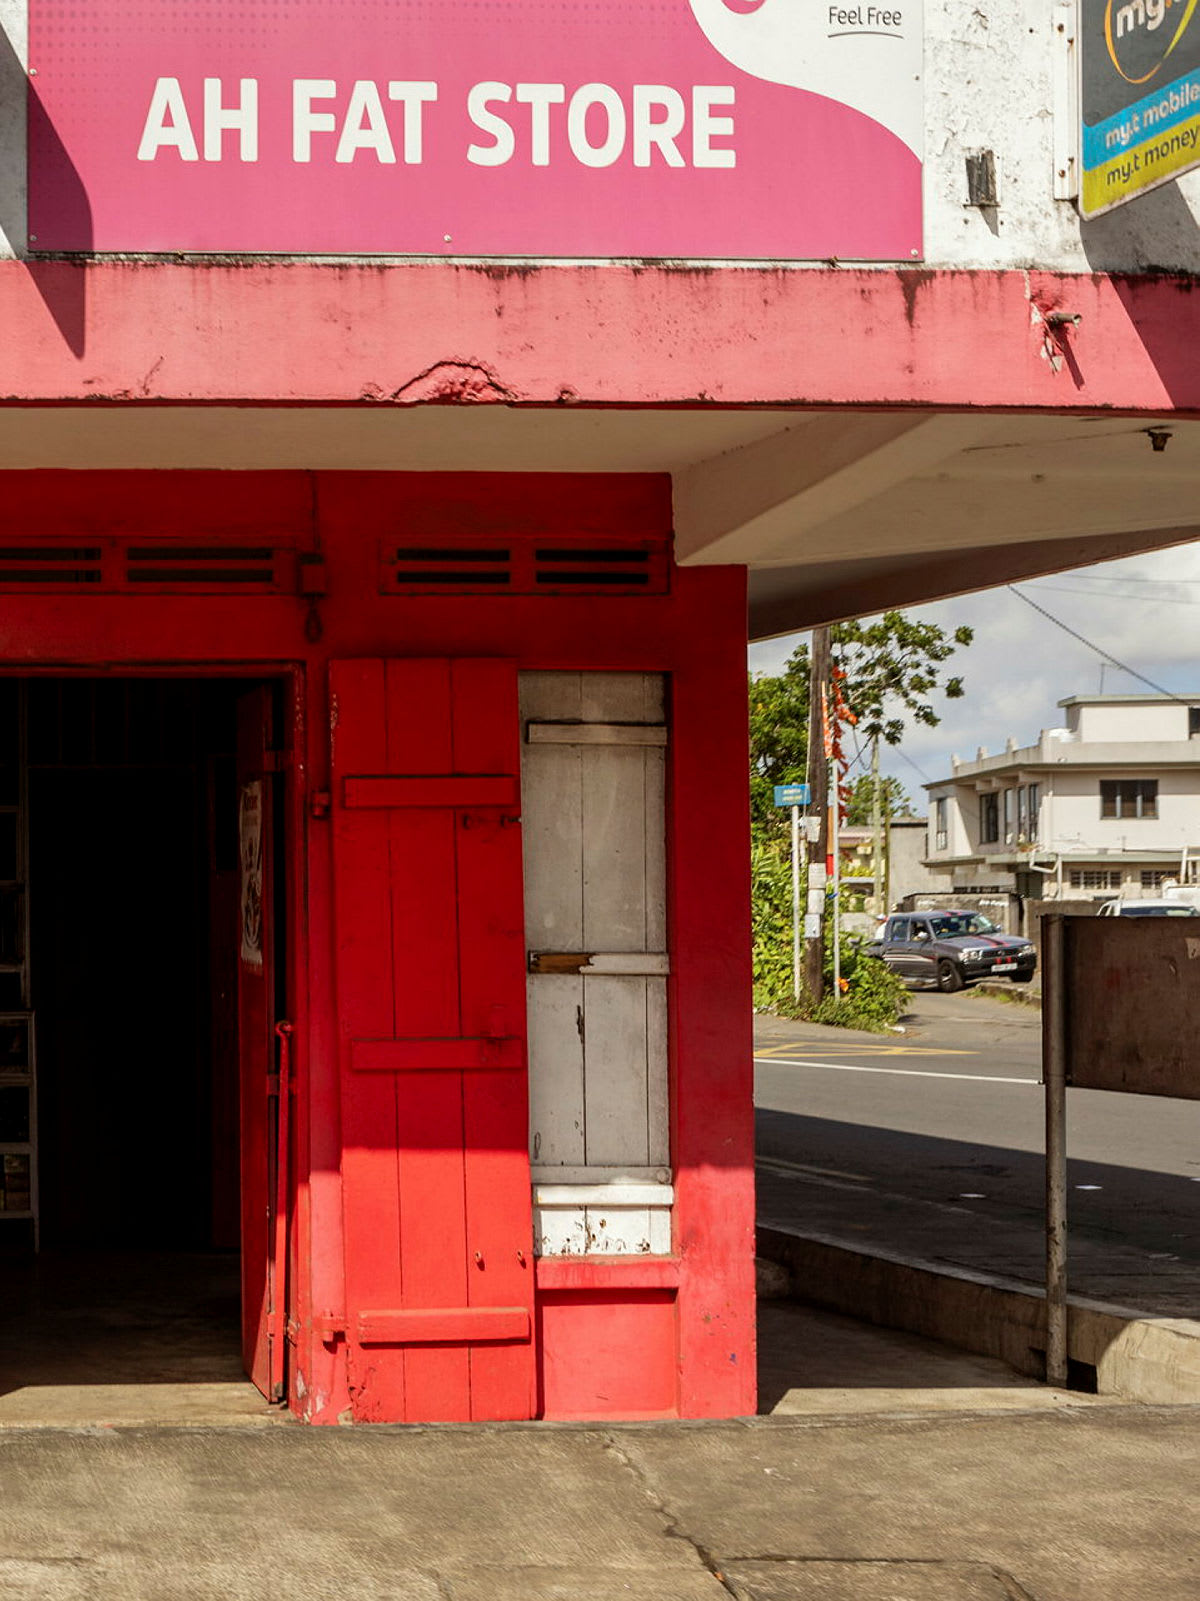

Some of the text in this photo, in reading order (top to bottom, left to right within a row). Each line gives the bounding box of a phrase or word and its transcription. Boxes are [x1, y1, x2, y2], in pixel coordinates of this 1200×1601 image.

[829, 6, 902, 26] Feel Free
[137, 78, 738, 168] AH FAT STORE
[1105, 82, 1200, 148] my.t mobile
[1106, 125, 1200, 185] my.t money
